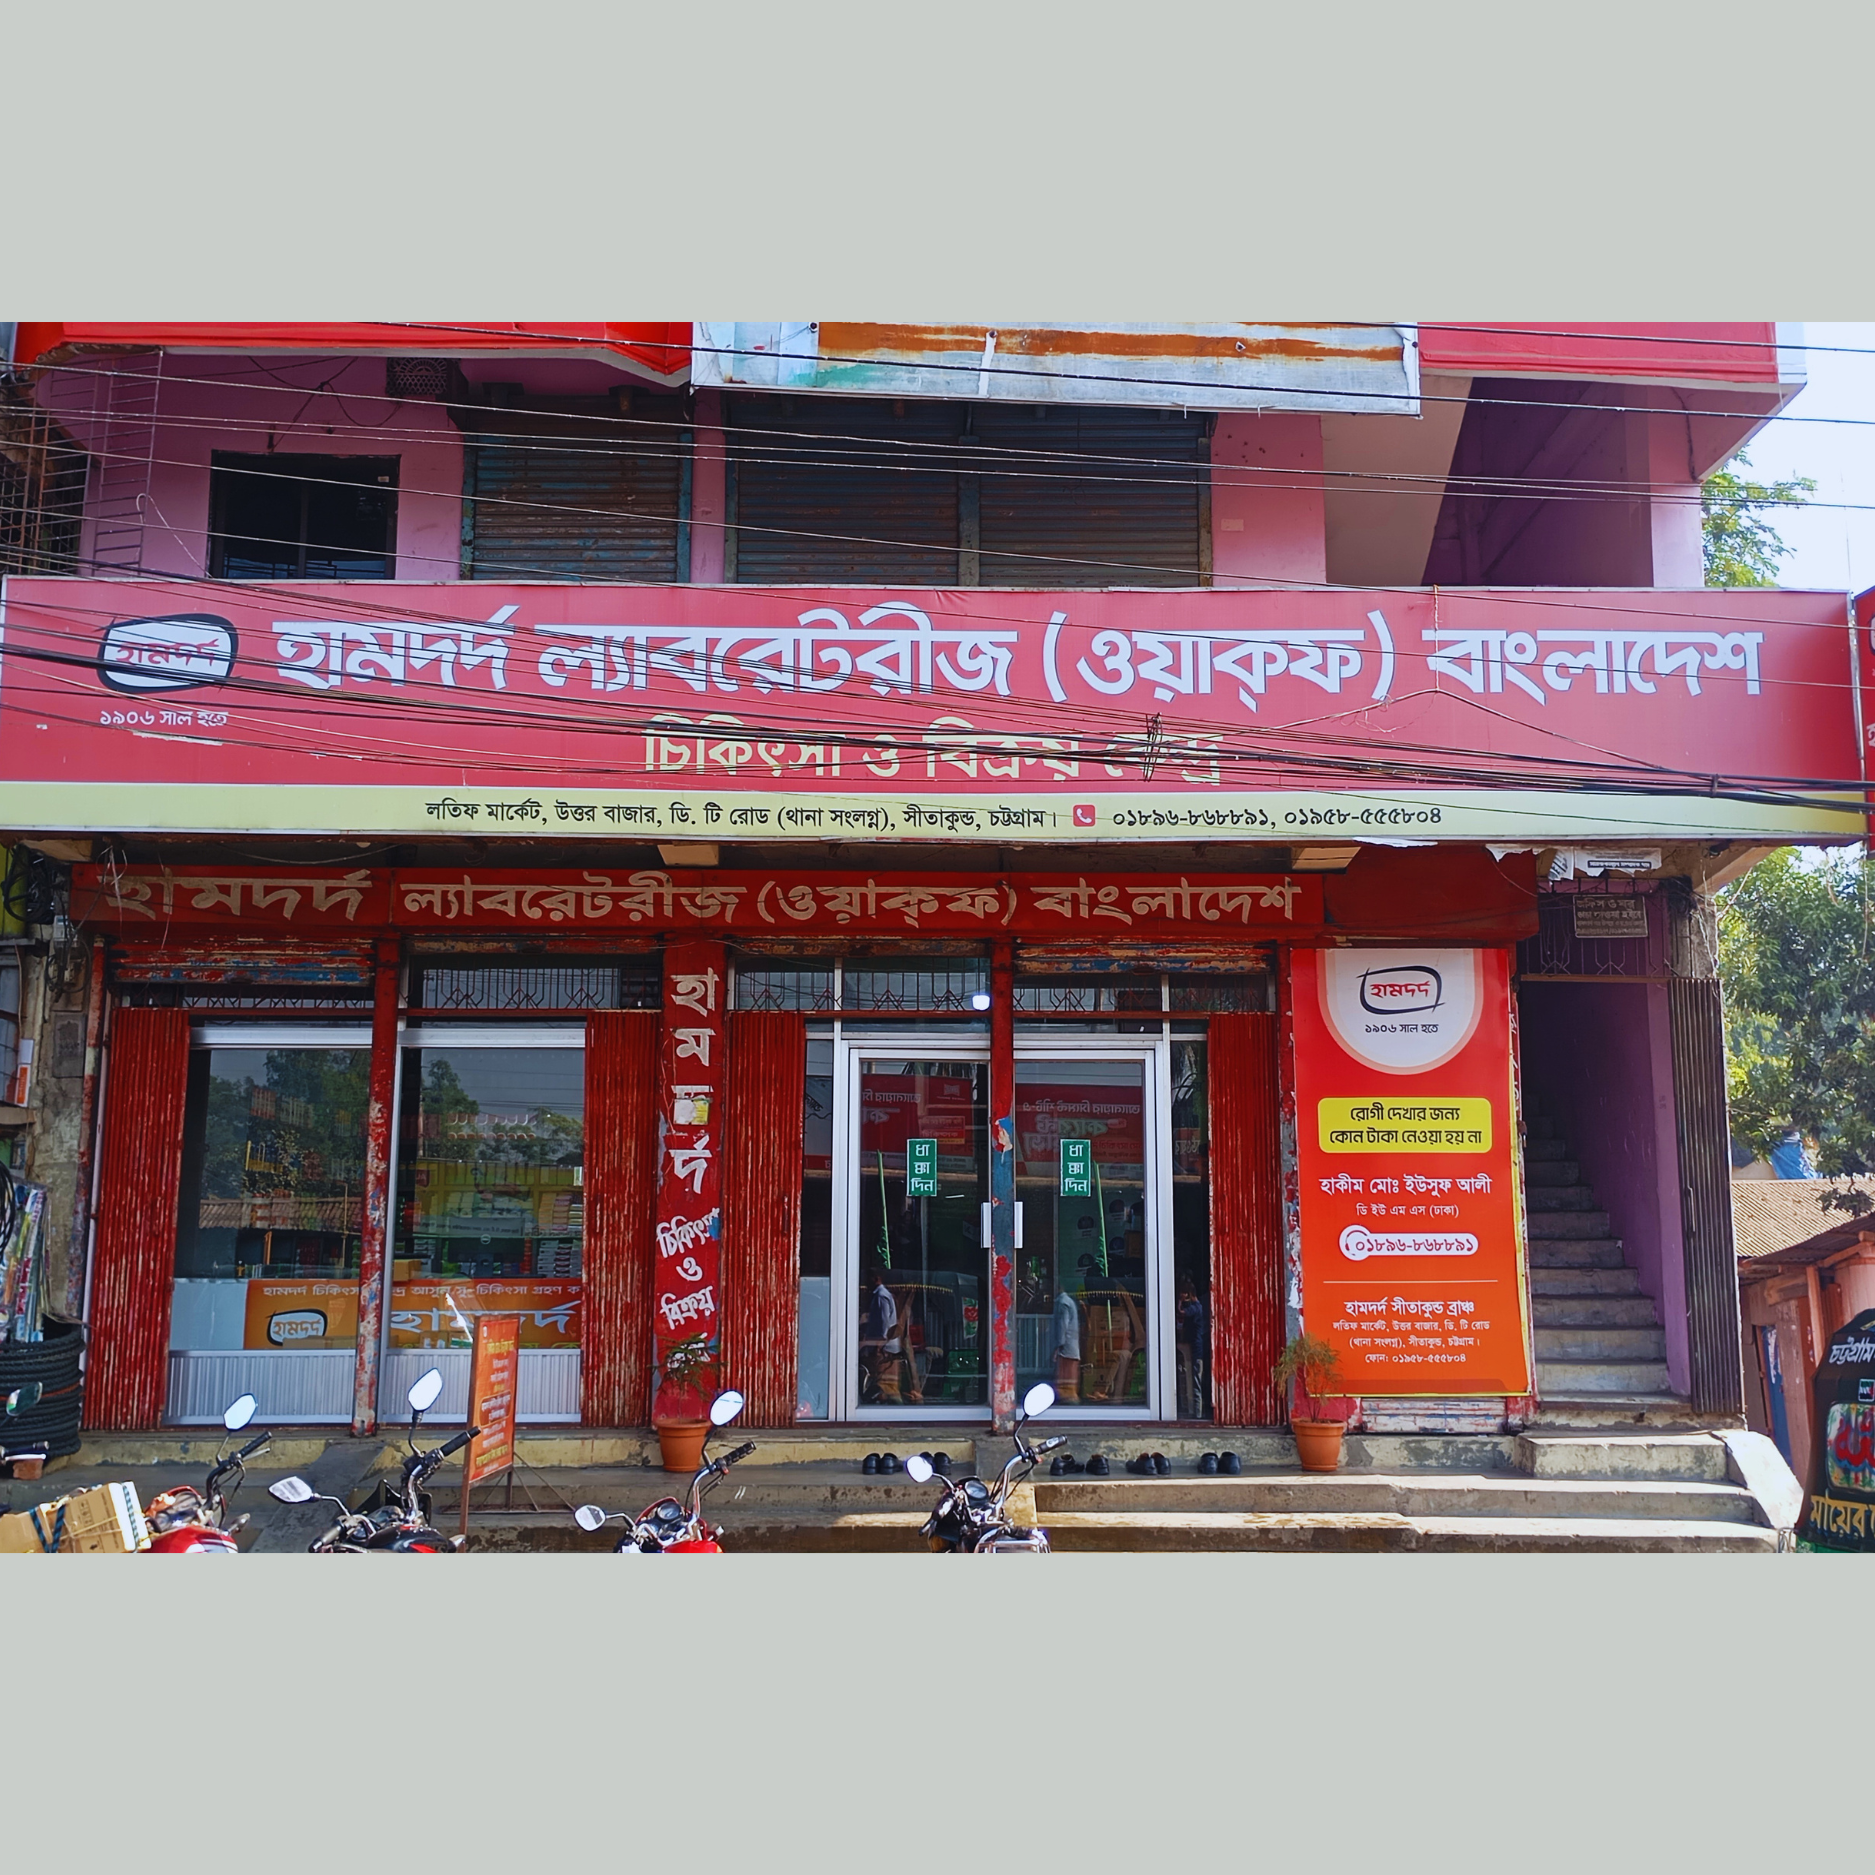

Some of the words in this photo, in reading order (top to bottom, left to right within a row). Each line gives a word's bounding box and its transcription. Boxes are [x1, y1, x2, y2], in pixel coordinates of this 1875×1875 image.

[272, 605, 520, 690] হামদর্দ
[534, 601, 1018, 697] ল্যাবরেটরীজ
[1421, 629, 1765, 706] বাংলাদেশ
[100, 710, 155, 726] ১৯০৬
[160, 710, 194, 726] সাল
[641, 712, 847, 778] চিকিৎসা
[862, 734, 900, 778] ও
[922, 716, 1084, 781] বিক্রয়
[425, 797, 481, 820] লতিফ
[486, 798, 548, 826] মার্কেট,
[554, 799, 598, 822] উত্তর
[602, 805, 662, 828] বাজার,
[669, 801, 697, 825] ডি.
[703, 803, 724, 825] টি
[729, 806, 771, 826] রোড
[778, 806, 824, 830] (থানা
[830, 805, 896, 832] সংলগ্ন),
[1112, 808, 1277, 829] ০১৮৯৬-৮৬৮৮৯১,
[1284, 807, 1442, 826] ০১৯৫৮-৫৫৫৮০৪
[97, 867, 372, 921] হামদর্দ
[400, 870, 748, 923] ল্যাবরেটরীজ
[1030, 876, 1302, 926] বাংলাদেশ
[1370, 980, 1431, 998] হামদর্দ
[1364, 1023, 1397, 1034] ১৯০৬
[1398, 1023, 1419, 1034] সাল
[1420, 1023, 1439, 1034] হতে
[1350, 1102, 1385, 1122] রোগী
[1387, 1107, 1427, 1122] দেখার
[1429, 1107, 1461, 1122] জন্য
[1329, 1130, 1364, 1145] কোন
[1366, 1127, 1399, 1145] টাকা
[1401, 1130, 1442, 1146] নেওয়া
[1444, 1130, 1465, 1146] হয়
[1466, 1130, 1482, 1145] না
[910, 1177, 934, 1194] দিন
[1064, 1177, 1087, 1194] দিন
[1319, 1173, 1364, 1196] হাকীম
[1403, 1173, 1453, 1198] ইউসুফ
[1455, 1172, 1493, 1195] আলী
[1356, 1202, 1368, 1217] ডি
[1370, 1202, 1387, 1216] ইউ
[1389, 1204, 1407, 1216] এম
[1409, 1204, 1427, 1216] এস
[1429, 1203, 1460, 1219] (ঢাকা)
[1355, 1237, 1474, 1253] ০১৮৯৬-৮৬৮৮৯১
[676, 1256, 703, 1282] ও
[263, 1284, 307, 1296] হামদর্দ
[312, 1283, 360, 1296] চিকিৎস
[411, 1286, 451, 1298] আসুন
[532, 1285, 562, 1296] গ্রহণ
[660, 1285, 716, 1331] বিক্রয়
[1344, 1297, 1389, 1317] হামদর্দ
[273, 1318, 322, 1336] হামদর্দ
[1332, 1319, 1359, 1331] লতিফ
[1361, 1319, 1389, 1333] মার্কেট,
[1391, 1320, 1412, 1331] উত্তর
[1414, 1320, 1442, 1333] বাজার,
[1444, 1319, 1457, 1331] ডি.
[1459, 1319, 1469, 1331] টি
[1471, 1320, 1490, 1331] রোড
[1349, 1336, 1372, 1349] (থানা
[1392, 1353, 1467, 1364] ০১৯৫৮-৫৫৫৮০৪
[1811, 1489, 1868, 1539] মায়ের
